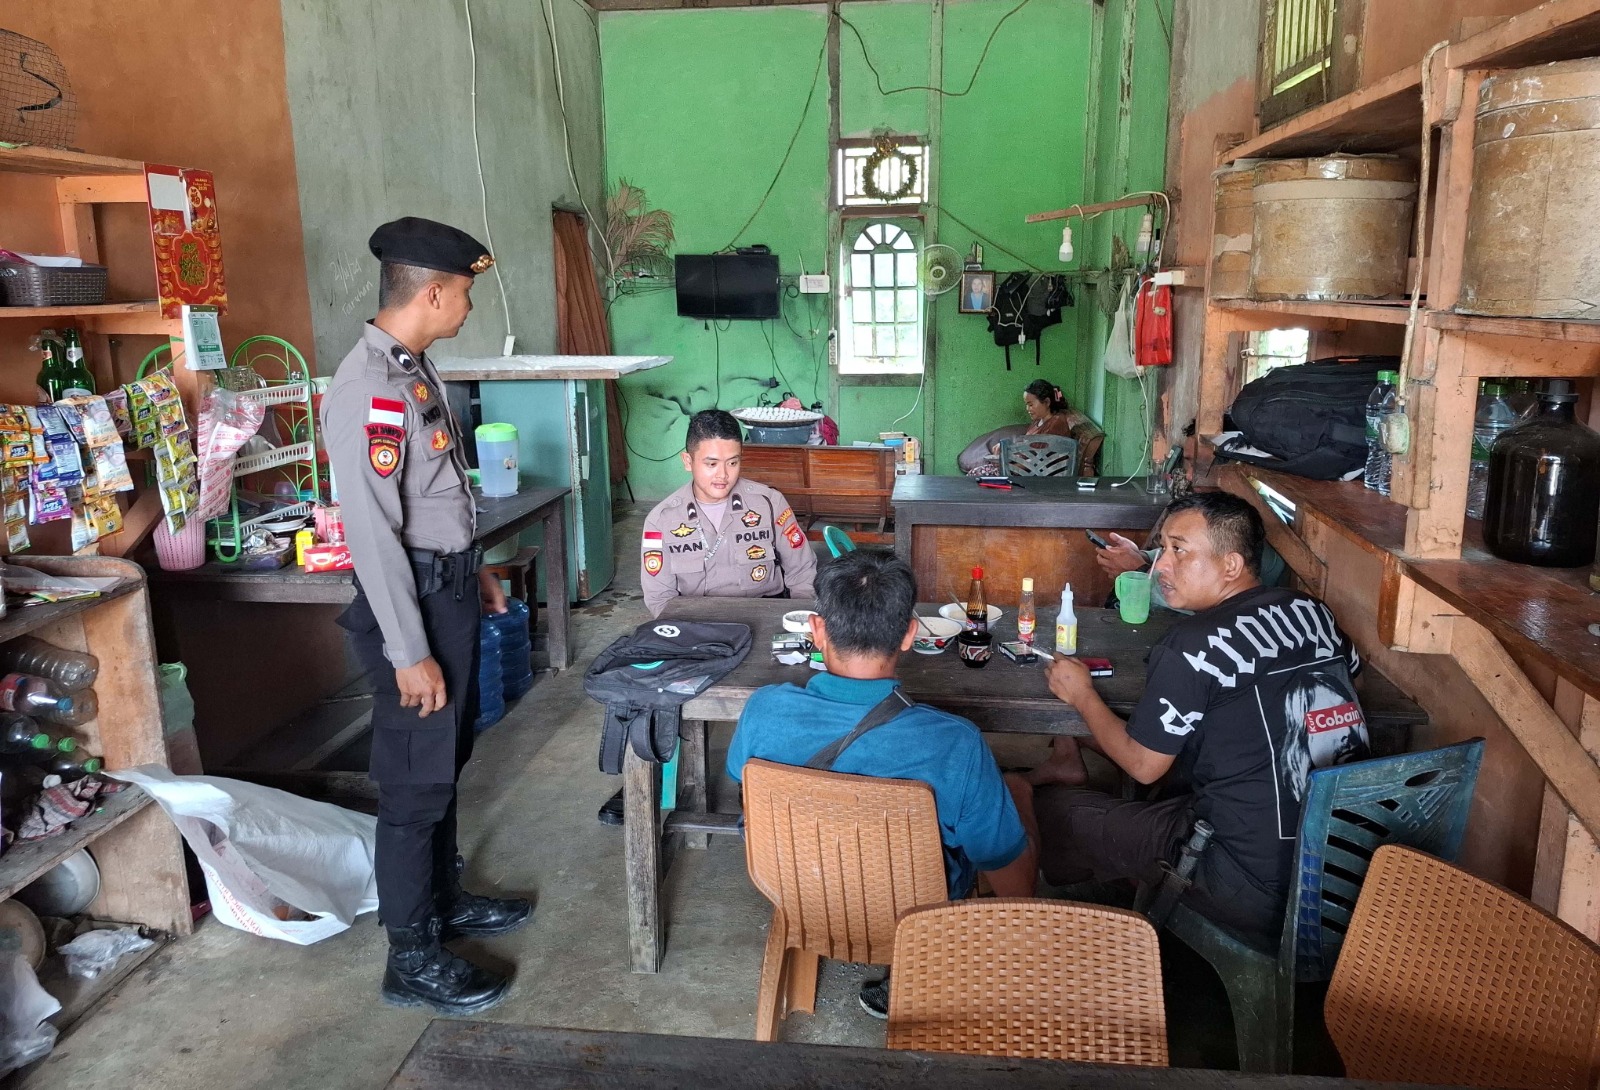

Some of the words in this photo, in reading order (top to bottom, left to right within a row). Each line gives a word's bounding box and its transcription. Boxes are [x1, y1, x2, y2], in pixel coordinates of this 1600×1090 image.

[735, 529, 770, 543] POLRI
[668, 541, 703, 553] IYAN
[1315, 706, 1360, 728] Cobain
